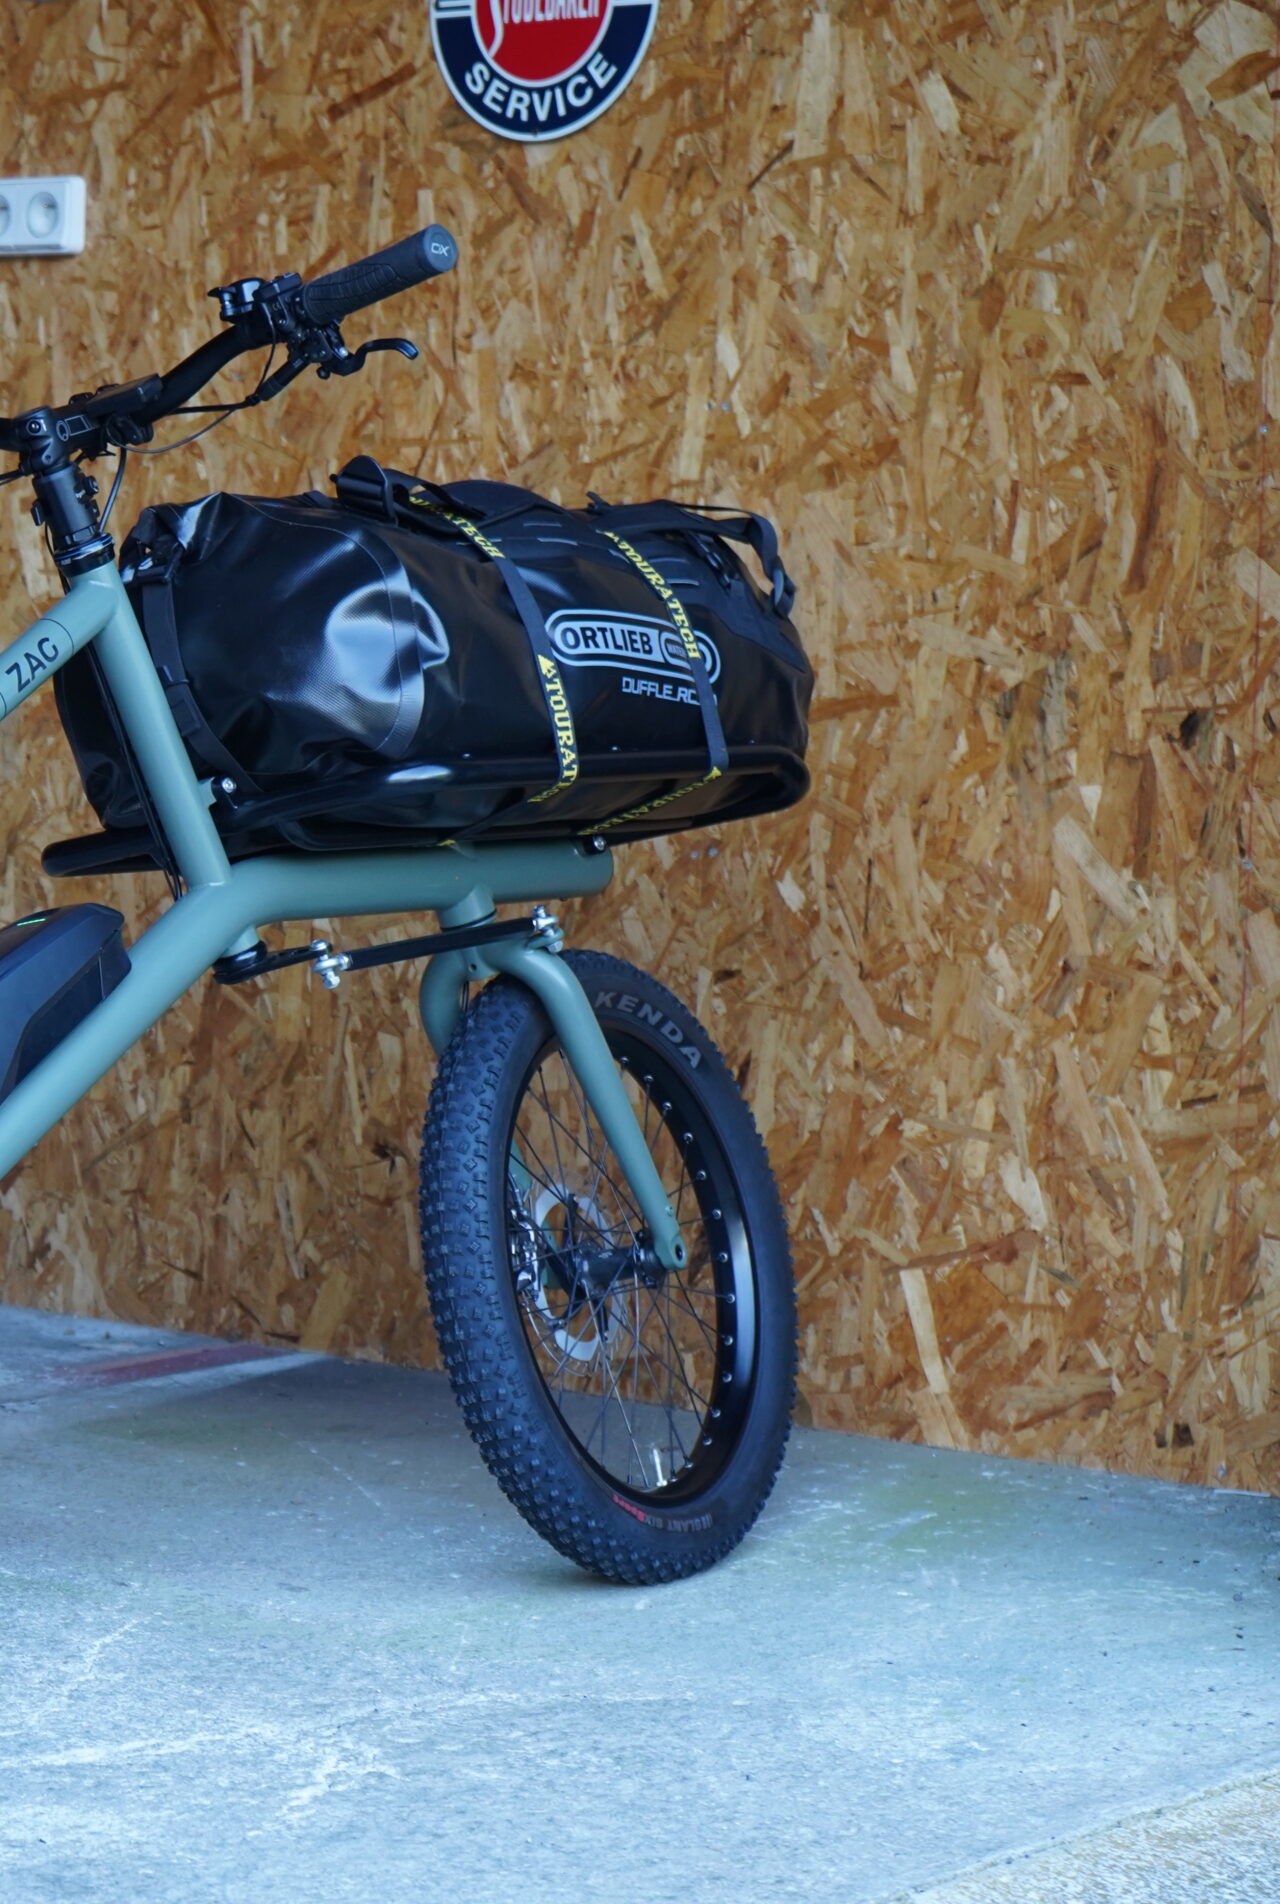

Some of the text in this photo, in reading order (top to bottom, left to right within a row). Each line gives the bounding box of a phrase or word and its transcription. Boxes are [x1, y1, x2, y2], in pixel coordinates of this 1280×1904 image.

[465, 52, 618, 122] SERVICE
[617, 540, 702, 659] TOURATECH
[560, 626, 653, 655] ORTLIEB
[594, 991, 701, 1069] KENDA
